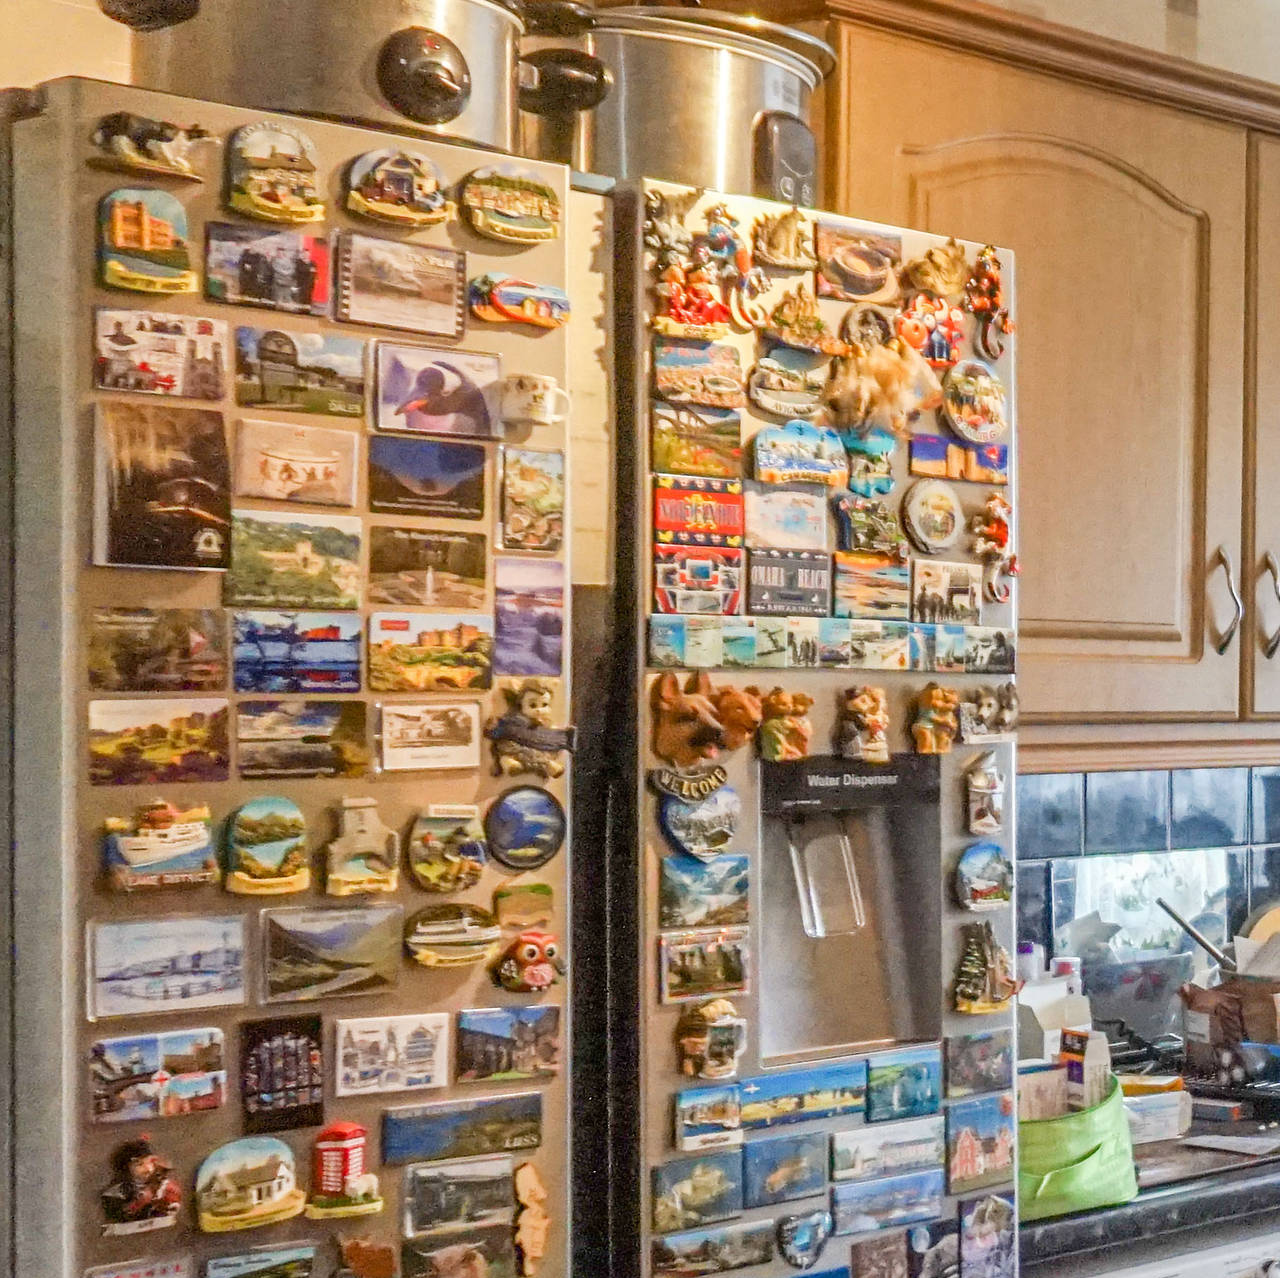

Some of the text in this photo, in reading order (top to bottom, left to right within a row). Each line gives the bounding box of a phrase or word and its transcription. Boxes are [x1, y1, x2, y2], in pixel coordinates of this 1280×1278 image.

[661, 768, 727, 798] WELCOME
[807, 774, 899, 788] Water Dispenser
